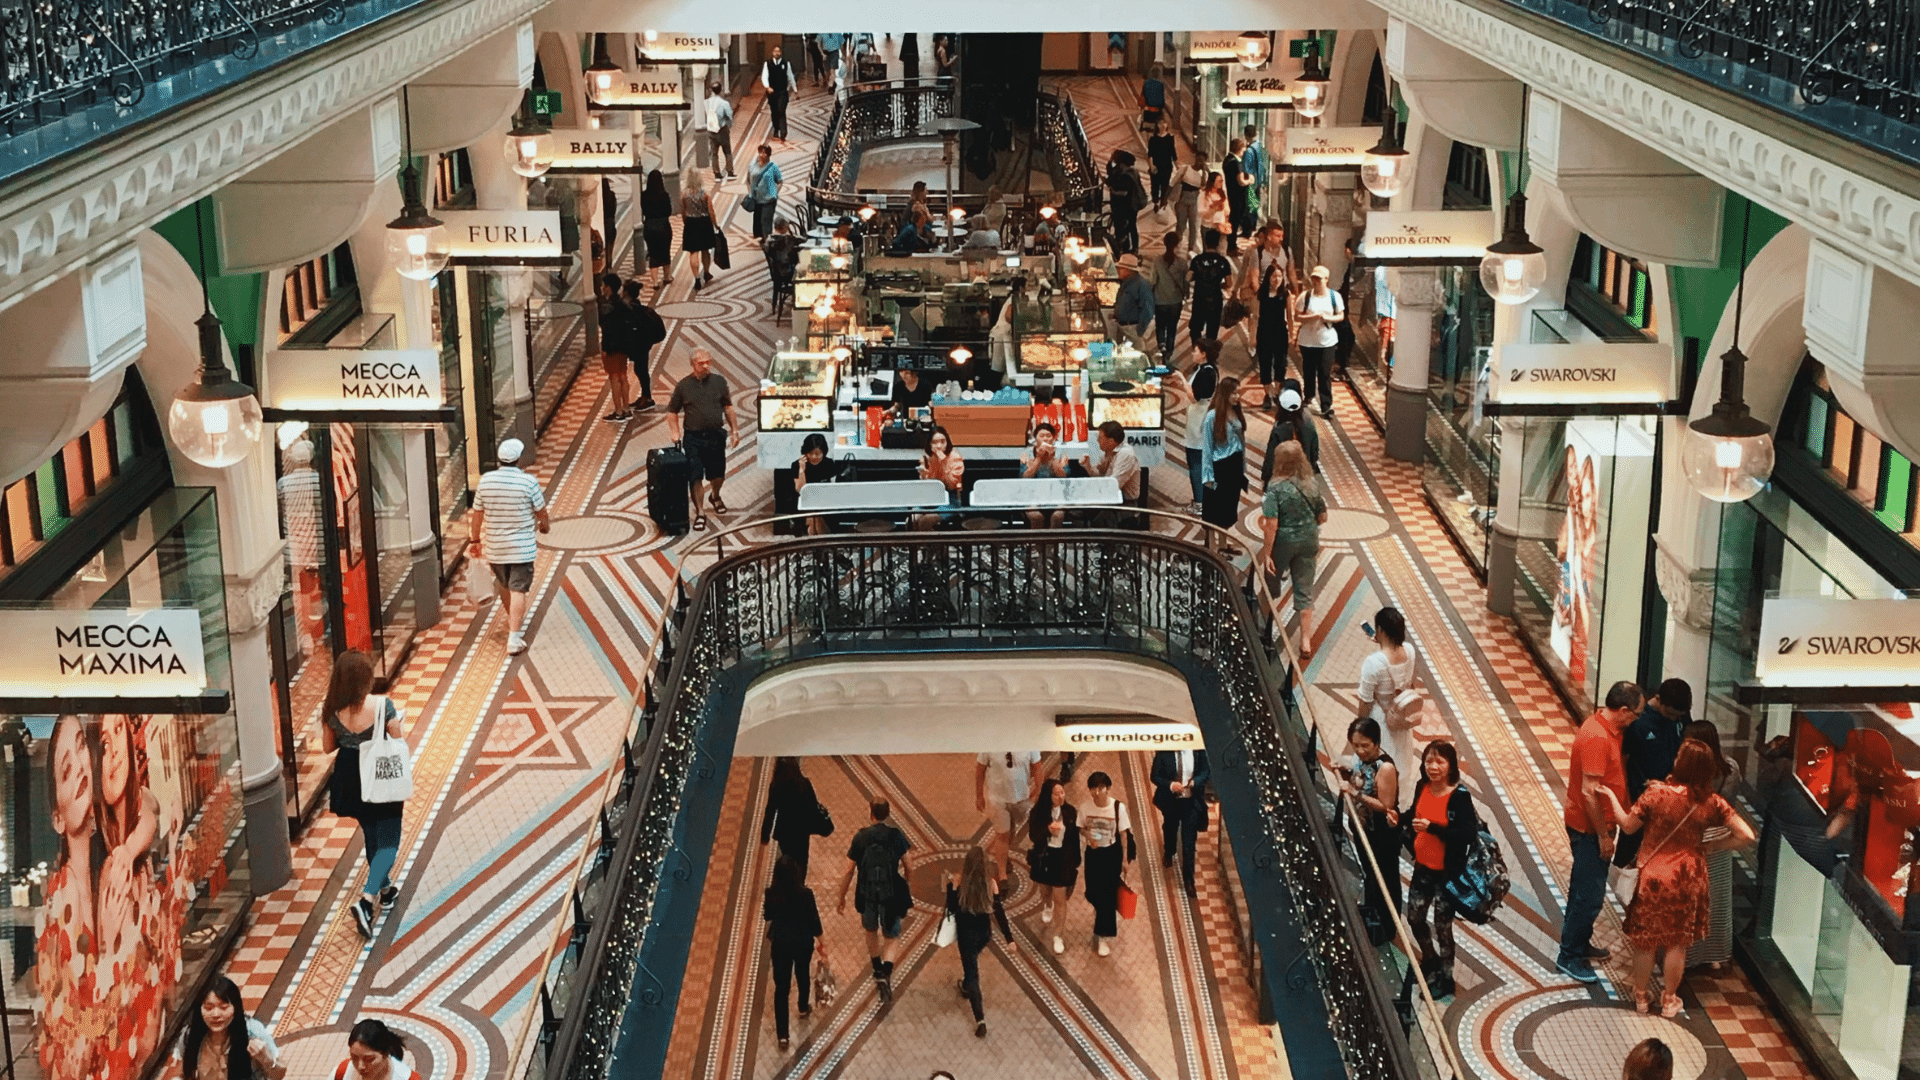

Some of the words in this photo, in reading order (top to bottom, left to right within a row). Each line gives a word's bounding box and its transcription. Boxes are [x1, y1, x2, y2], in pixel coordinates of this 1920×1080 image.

[675, 37, 714, 46] FOSSIL
[630, 83, 678, 94] BALLY
[1236, 79, 1257, 96] Folli
[1260, 78, 1286, 94] Follie
[570, 142, 627, 154] BALLY
[468, 226, 553, 244] FURLA
[1375, 236, 1407, 245] RODD
[1408, 236, 1416, 244] &
[1418, 236, 1451, 245] GUNN
[341, 363, 421, 380] MECCA
[1530, 368, 1616, 382] SWAROVSKI
[342, 383, 430, 399] MAXIMA
[1127, 436, 1161, 446] PARISI
[56, 624, 172, 648] MECCA
[59, 652, 187, 675] MAXIMA
[1071, 732, 1194, 743] dermalogica
